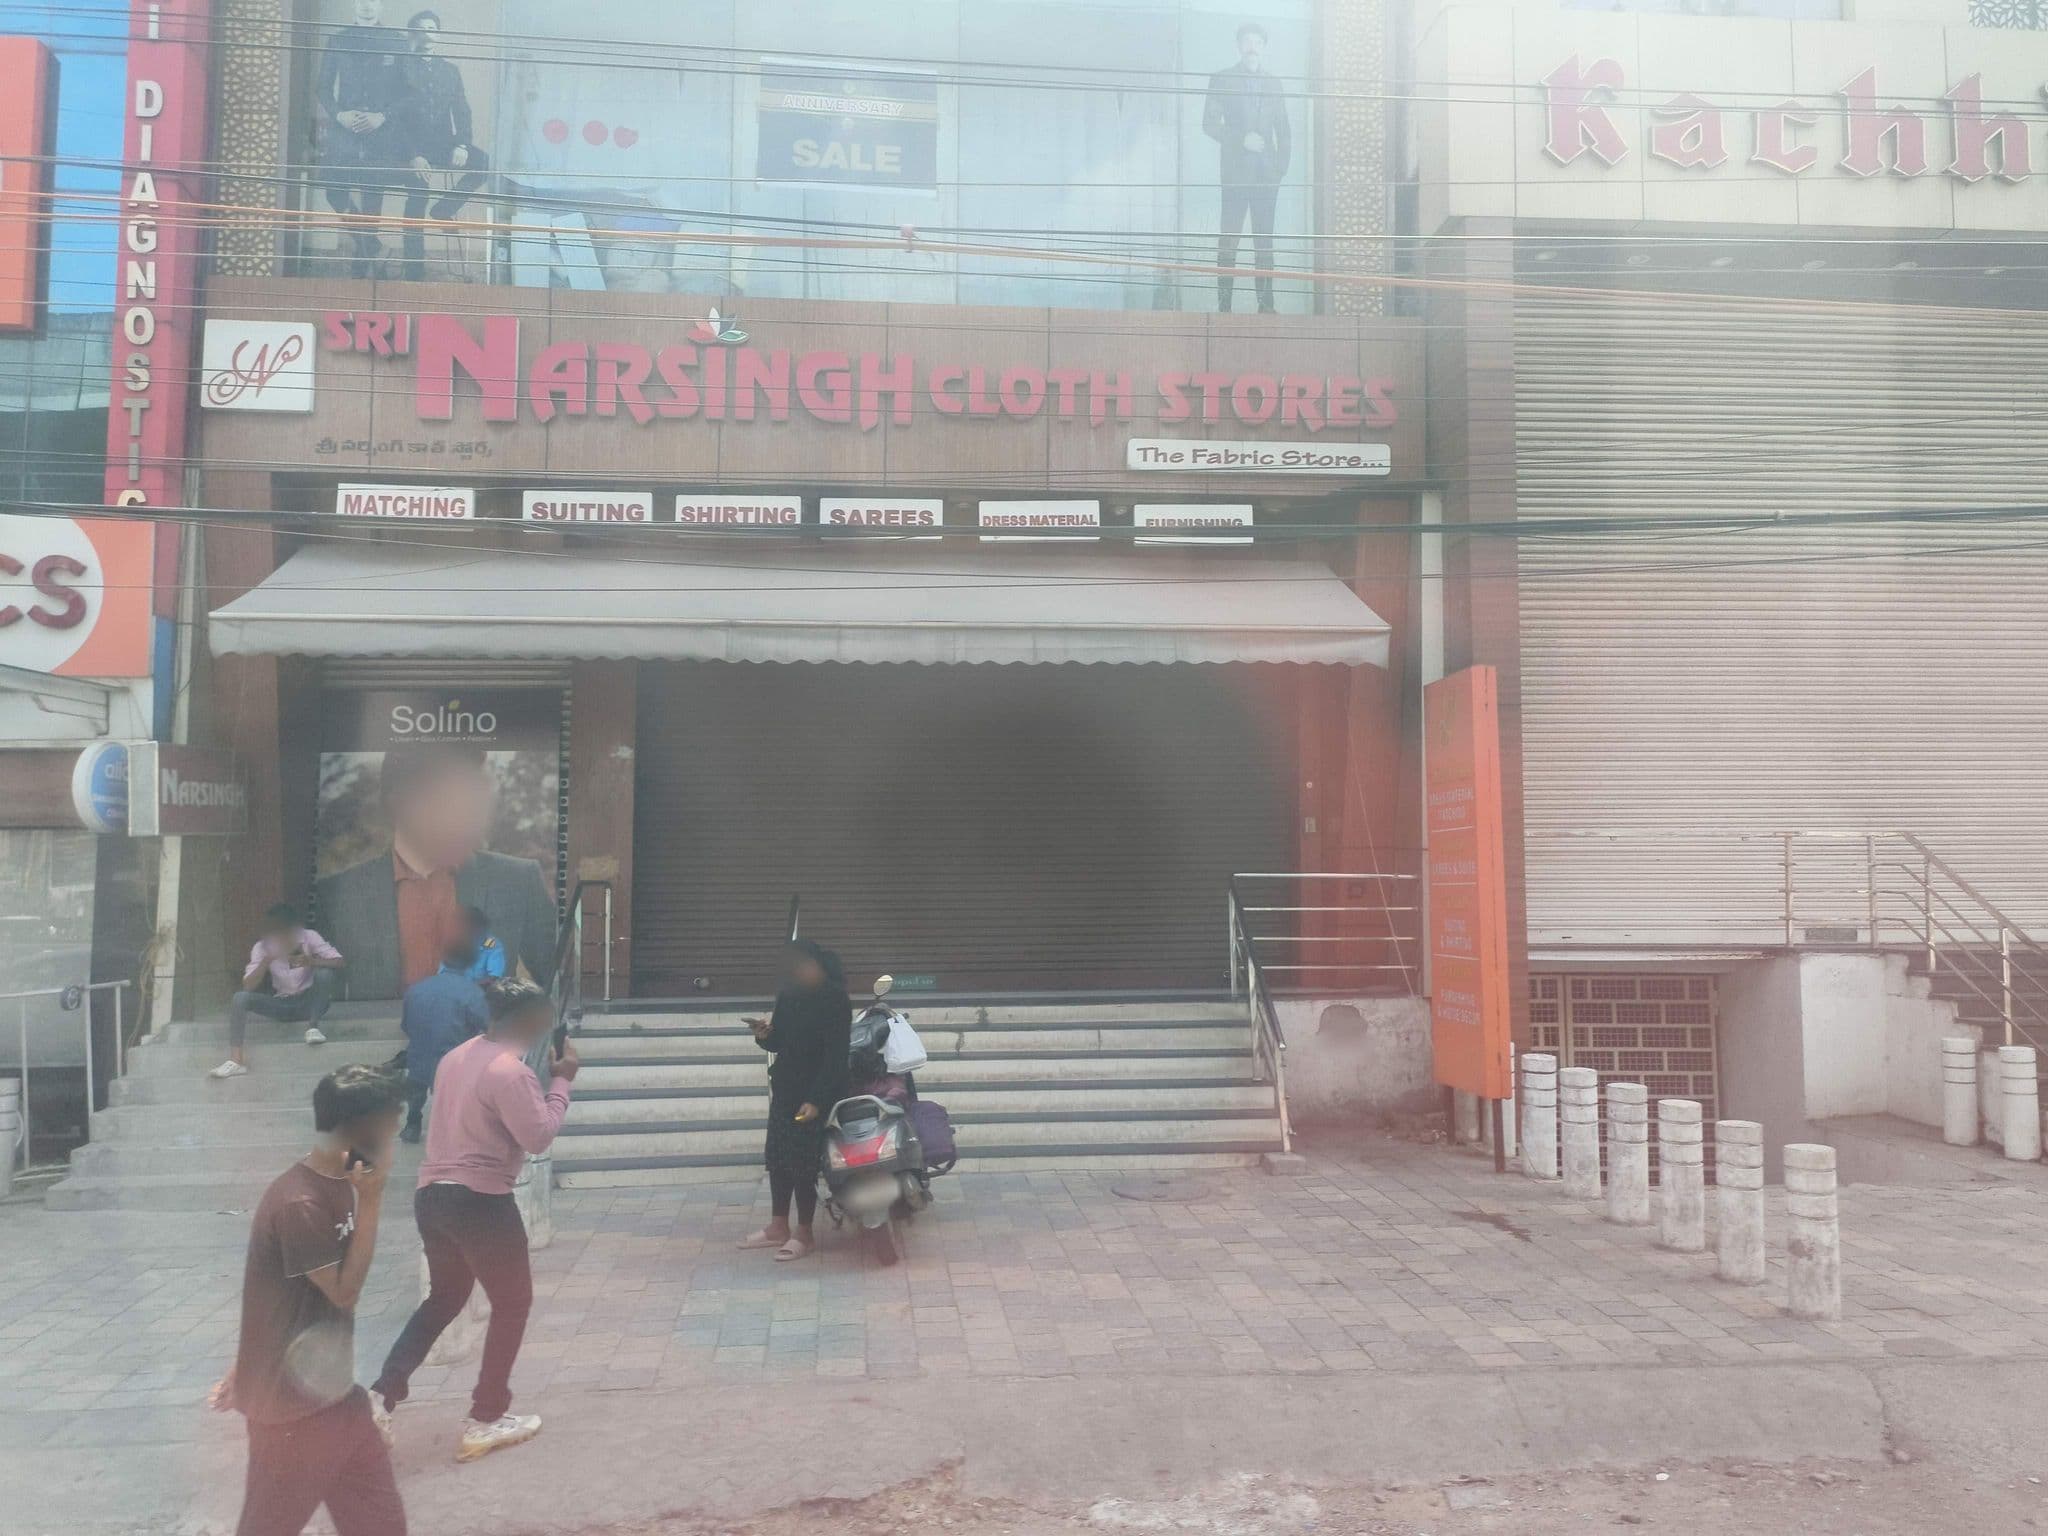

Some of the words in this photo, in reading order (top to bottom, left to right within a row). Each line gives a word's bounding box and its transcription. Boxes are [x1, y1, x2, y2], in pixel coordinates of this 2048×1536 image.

[783, 94, 905, 116] ANNIVERSARY
[792, 138, 902, 175] SALE
[322, 310, 410, 357] SRI
[416, 313, 913, 432] NARSINGH
[928, 364, 1134, 429] CLOTH
[1157, 371, 1399, 432] STORES
[1136, 446, 1184, 464] The
[1192, 447, 1275, 466] Fabric
[1281, 450, 1384, 468] Store...
[343, 493, 466, 519] MATCHING
[531, 501, 645, 521] SUITING
[680, 506, 797, 525] SHIRTING
[830, 508, 934, 526] SAREES
[982, 514, 1027, 527] DRESS
[1029, 514, 1098, 527] MATERIAL
[391, 699, 497, 734] Solino
[161, 768, 246, 808] NARSINGH
